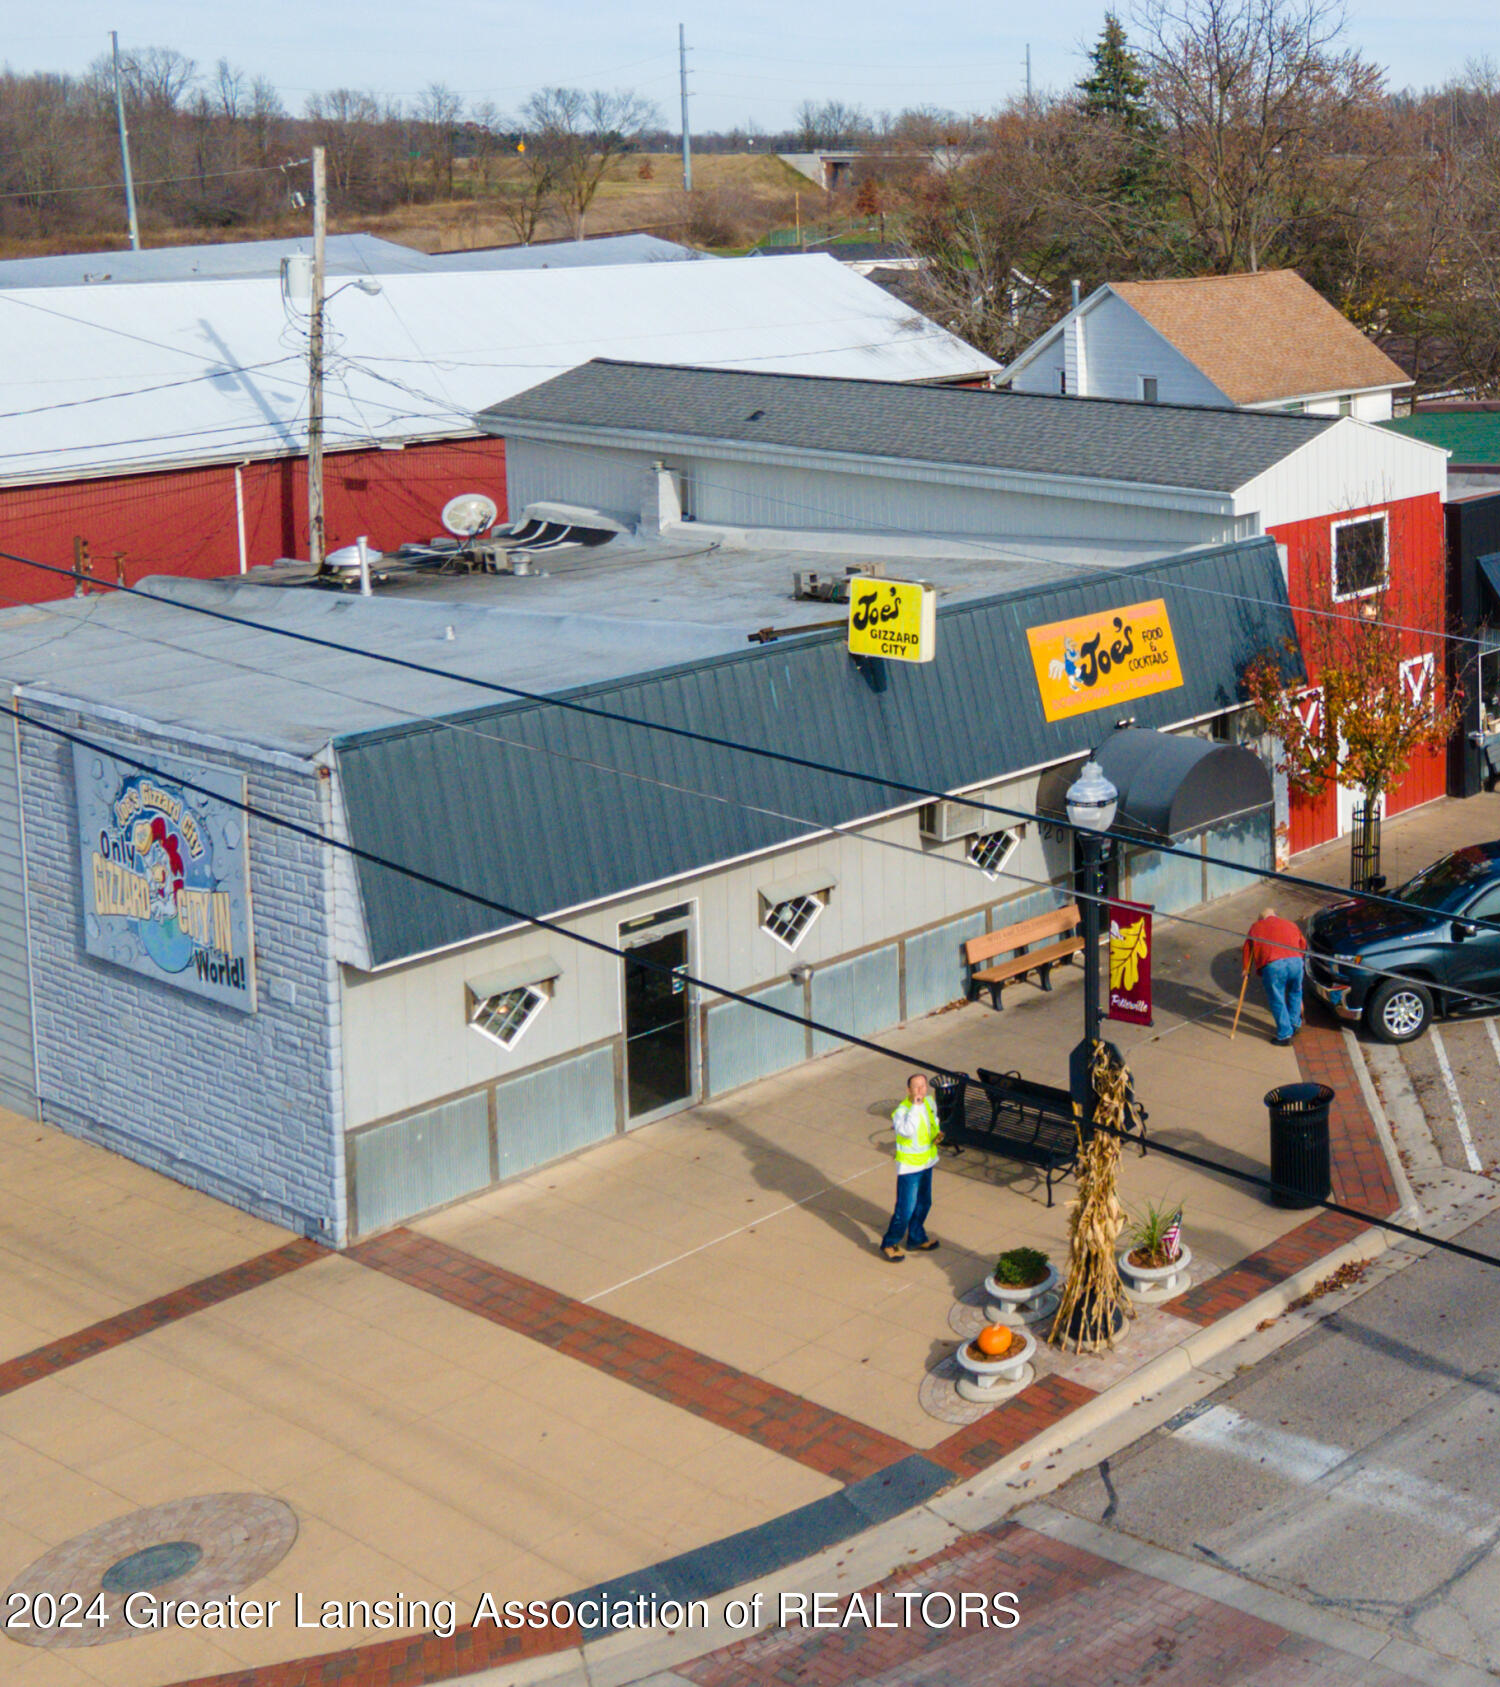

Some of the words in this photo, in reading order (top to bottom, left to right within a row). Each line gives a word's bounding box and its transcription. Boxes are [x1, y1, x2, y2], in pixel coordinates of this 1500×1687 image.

[853, 587, 902, 631] Joe's
[870, 629, 919, 645] GIZZARD
[881, 643, 906, 656] CITY
[1080, 617, 1134, 687] Joe's
[1142, 627, 1163, 642] FOOD
[1128, 651, 1169, 672] COCKTAILS
[101, 829, 136, 869] Only
[92, 852, 151, 920] GIZZARD
[177, 888, 209, 945] CITY
[213, 892, 233, 959] IN
[195, 949, 246, 991] World!
